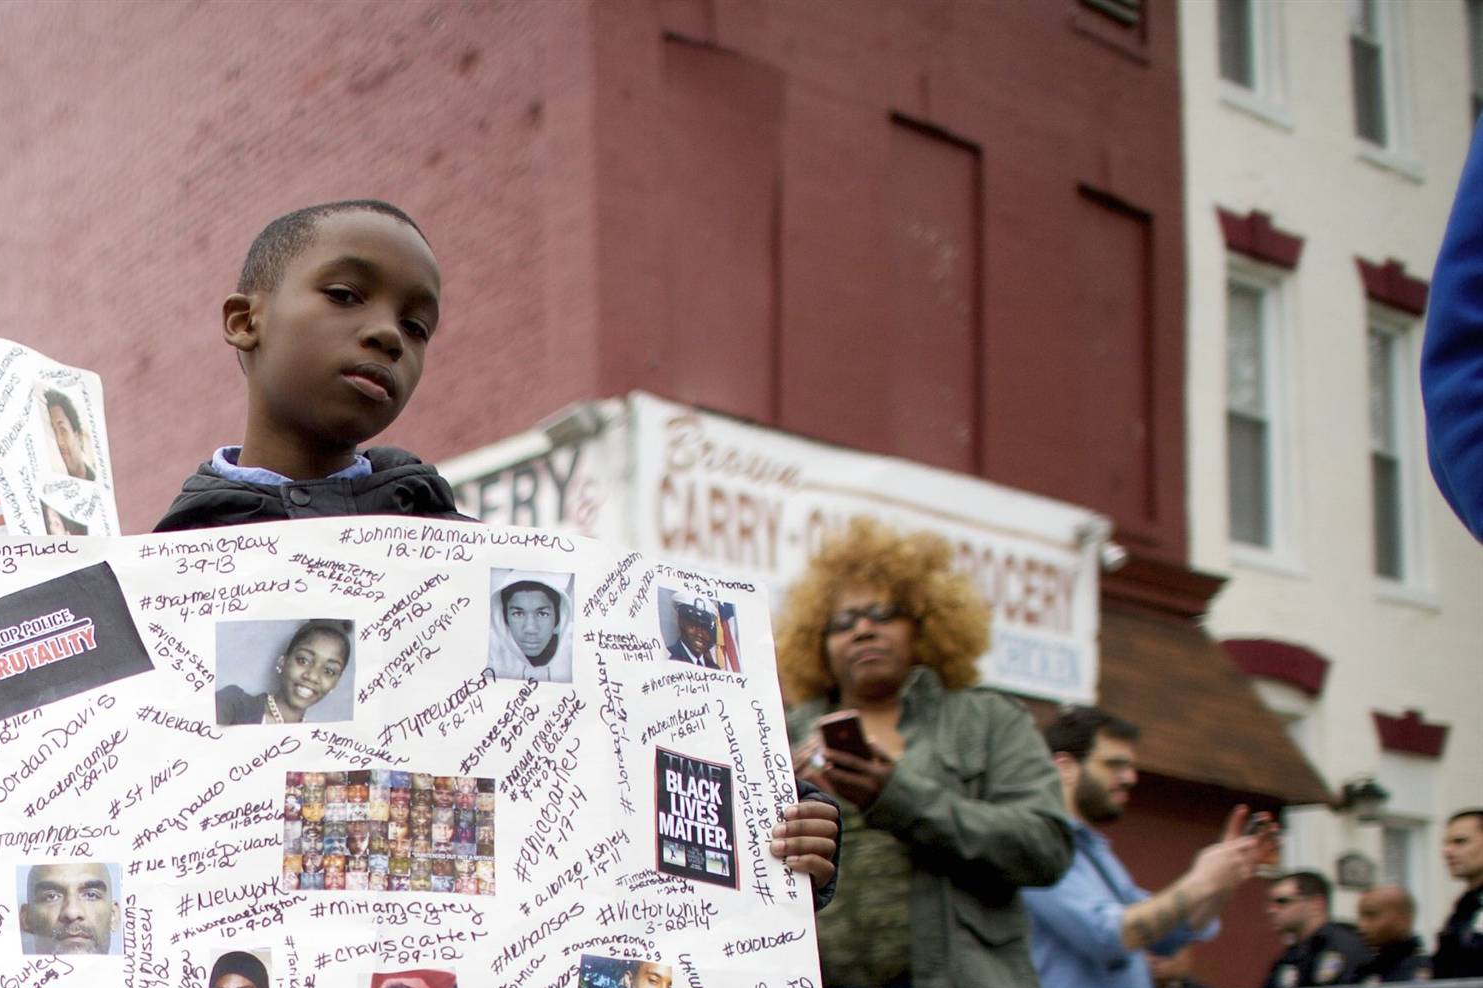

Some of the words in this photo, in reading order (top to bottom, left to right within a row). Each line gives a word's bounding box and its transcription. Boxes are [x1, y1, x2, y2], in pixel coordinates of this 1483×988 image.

[22, 609, 73, 638] POLICE
[662, 751, 722, 783] TIME
[665, 768, 723, 806] BLACK
[670, 793, 720, 827] LIVES
[658, 811, 733, 852] MATTER.
